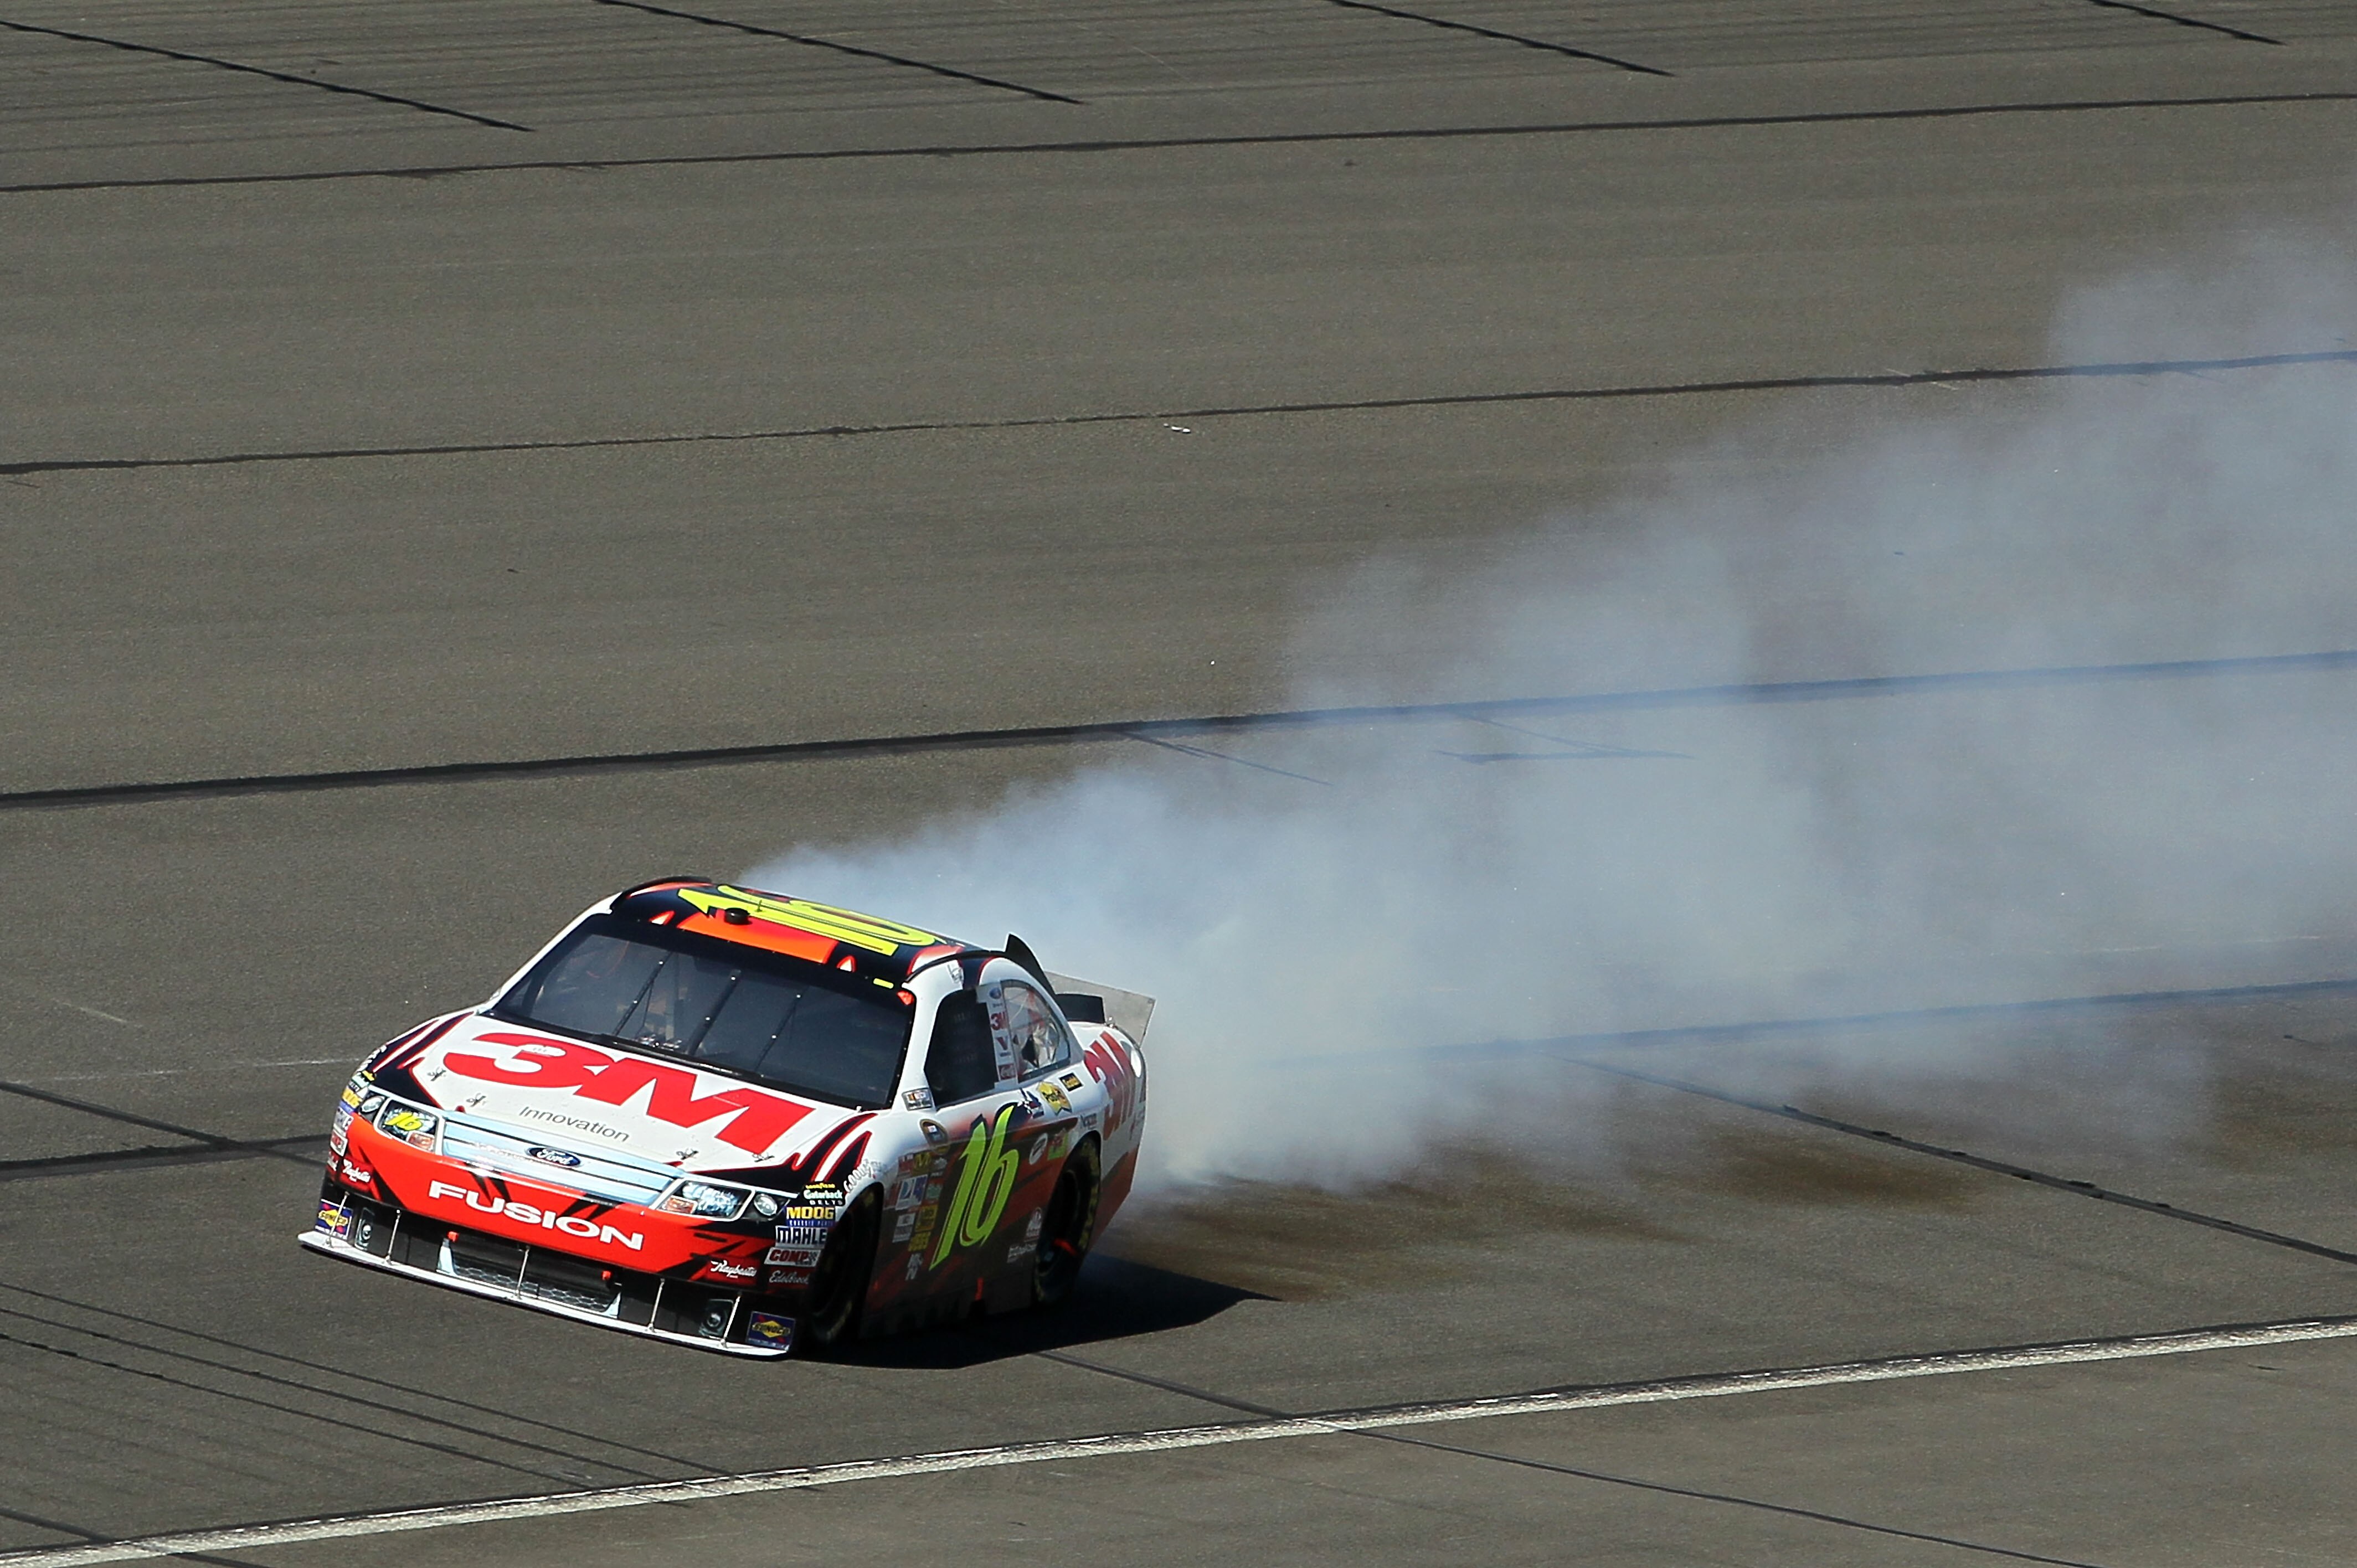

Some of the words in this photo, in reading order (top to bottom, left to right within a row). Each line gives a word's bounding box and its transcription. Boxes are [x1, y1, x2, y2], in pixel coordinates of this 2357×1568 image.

[443, 1032, 816, 1154] 3M
[384, 1111, 423, 1131] 16
[518, 1106, 630, 1143] Innovation
[538, 1148, 574, 1165] Ford
[928, 1104, 1020, 1272] 16
[428, 1180, 644, 1251] FUSION
[786, 1206, 835, 1220] MOOG
[777, 1227, 827, 1245] MAHLE
[769, 1249, 809, 1262] COMP
